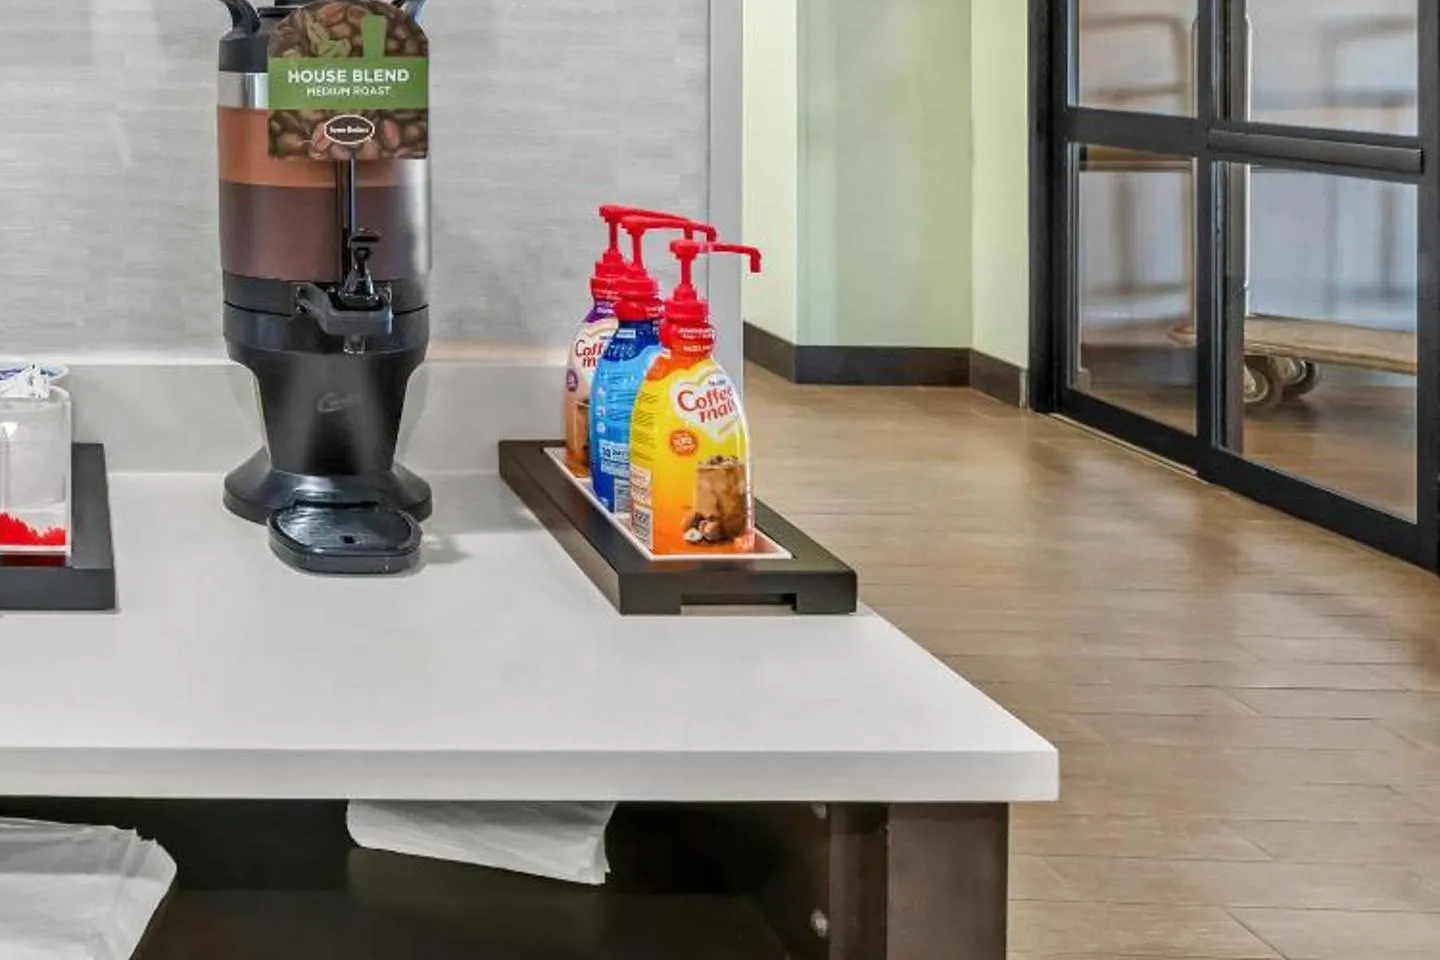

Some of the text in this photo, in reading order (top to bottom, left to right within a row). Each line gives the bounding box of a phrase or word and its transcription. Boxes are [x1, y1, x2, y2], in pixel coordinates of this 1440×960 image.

[287, 68, 409, 83] HOUSE BLEND
[306, 85, 392, 97] MEDIUM ROAST
[575, 339, 603, 357] Coff
